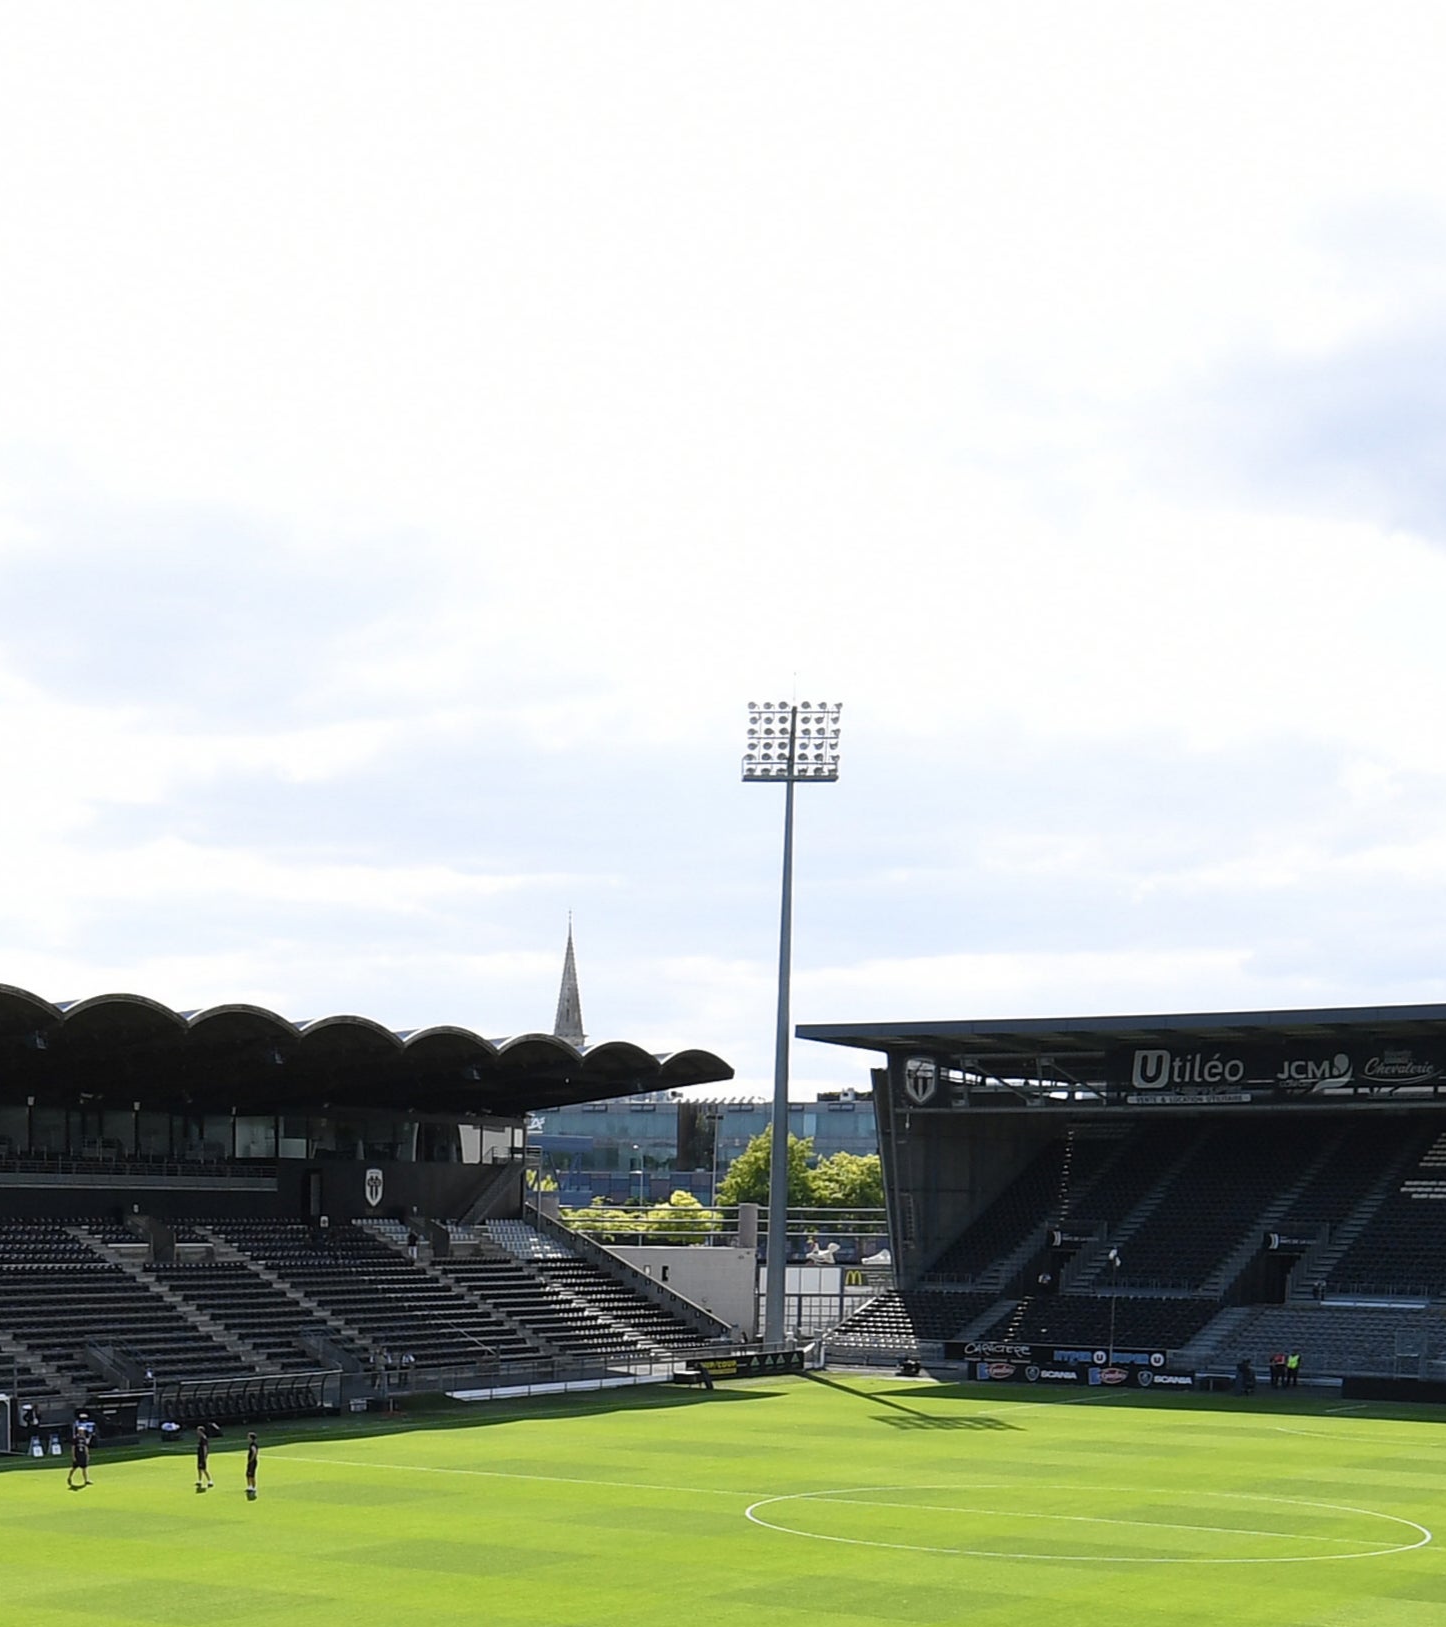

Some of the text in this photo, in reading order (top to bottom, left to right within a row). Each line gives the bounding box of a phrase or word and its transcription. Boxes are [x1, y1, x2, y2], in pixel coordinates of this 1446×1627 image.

[1133, 1049, 1245, 1088] Utiléo
[1276, 1060, 1330, 1079] JCM
[1364, 1056, 1434, 1076] Chevalerie
[1040, 1370, 1078, 1380] SCANIA
[1153, 1375, 1193, 1384] SCANIA
